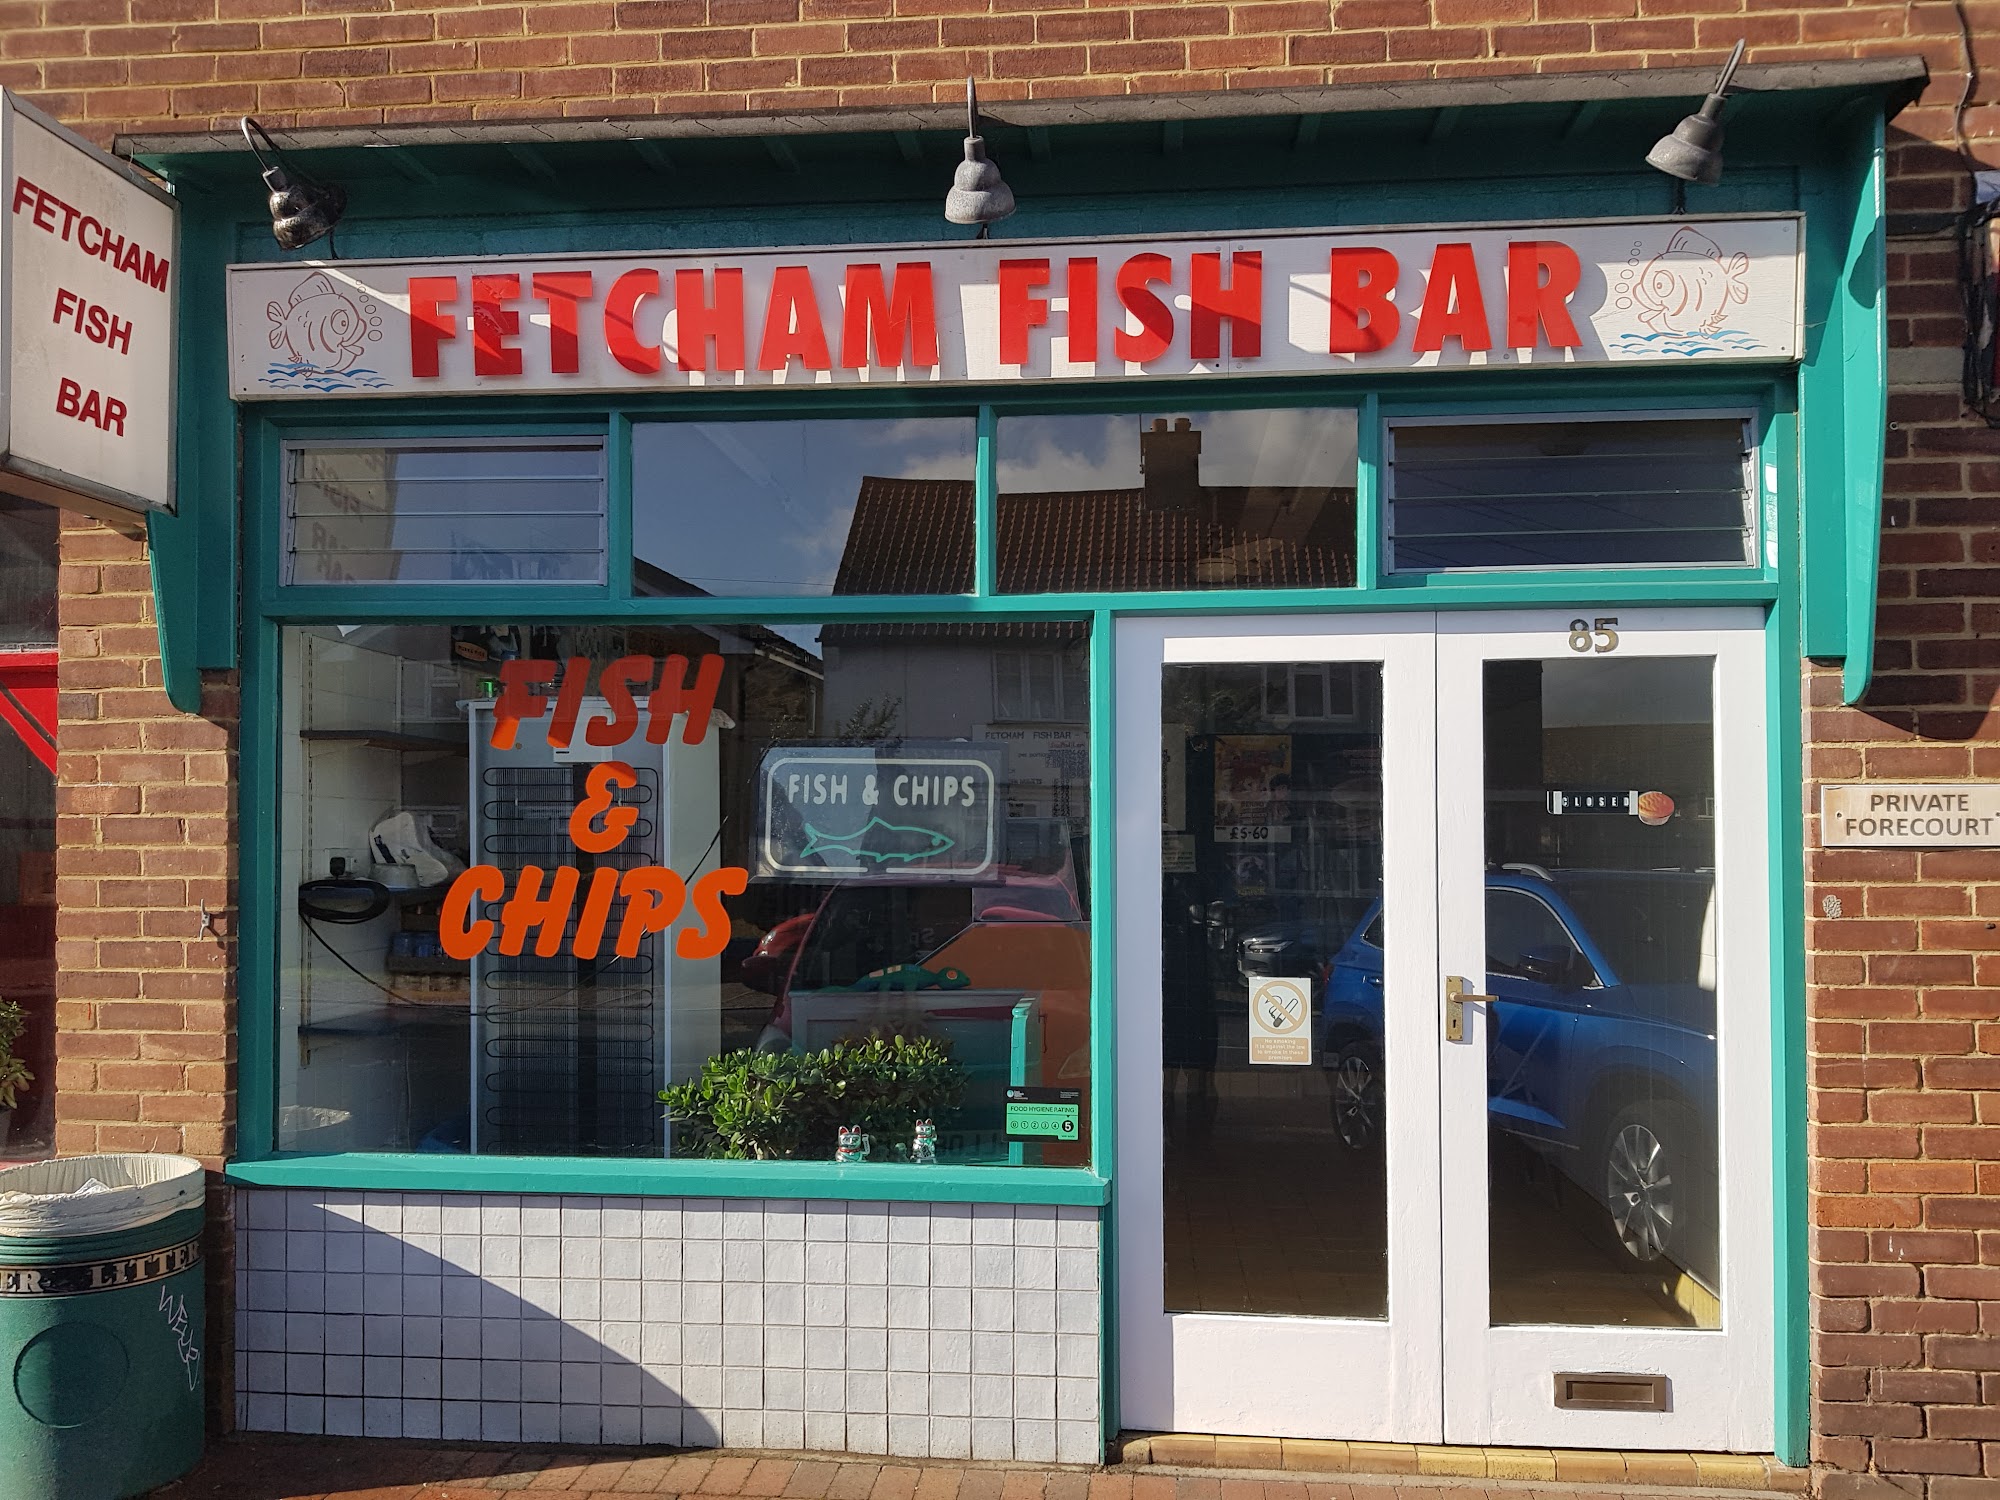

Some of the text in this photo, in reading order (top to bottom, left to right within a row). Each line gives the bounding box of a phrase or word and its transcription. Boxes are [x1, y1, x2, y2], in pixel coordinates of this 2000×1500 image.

[12, 176, 170, 294] FETCHAM
[53, 287, 133, 356] FISH
[408, 241, 1583, 378] FETCHAM FISH BAR
[55, 376, 128, 438] BAR
[1568, 617, 1619, 654] 85
[490, 654, 725, 751] FISH
[985, 731, 1025, 740] FETCHAM
[1033, 731, 1052, 740] FISH
[1053, 731, 1071, 740] BAR
[569, 760, 640, 854] &
[788, 773, 976, 807] FISH & CHIPS
[1562, 796, 1630, 808] CLOSED
[1870, 794, 1970, 812] PRIVATE
[1845, 818, 1994, 836] FORECOURT
[438, 864, 749, 961] CHIPS
[90, 1240, 200, 1288] LITTER
